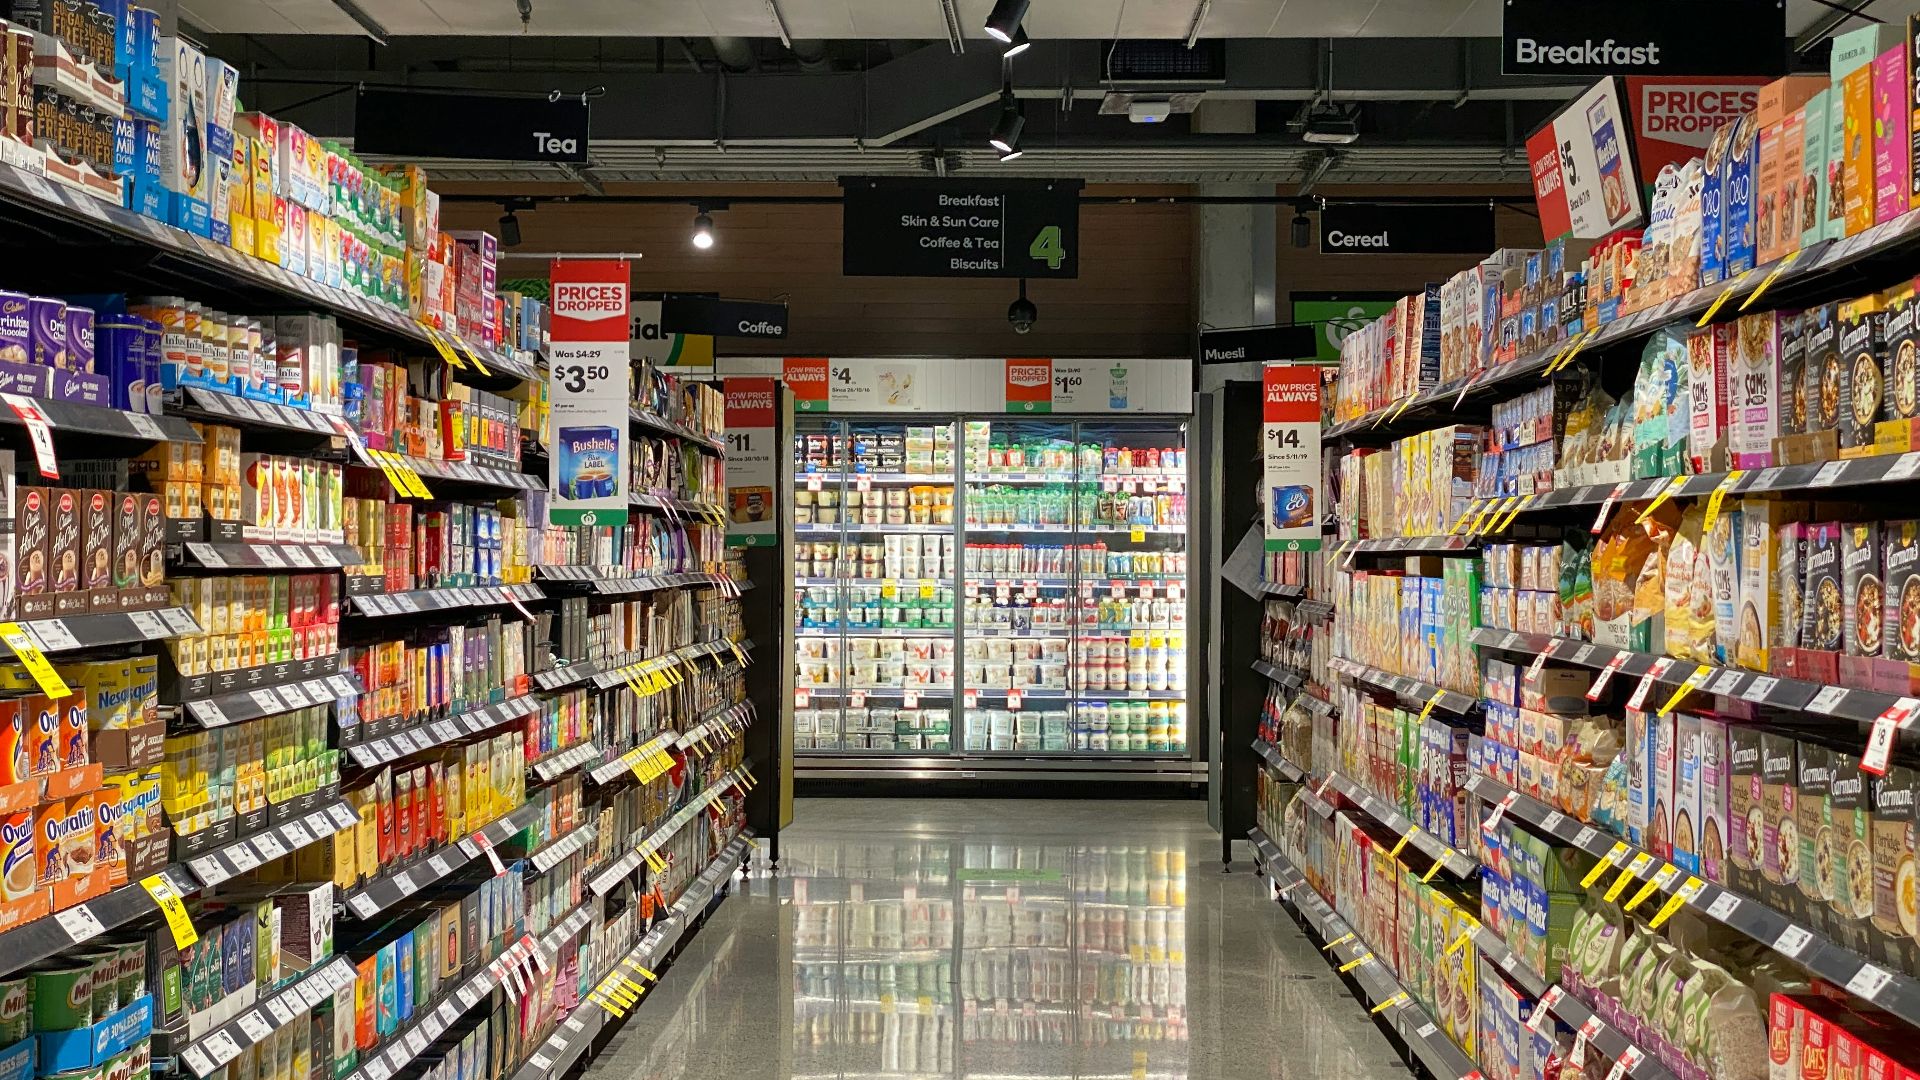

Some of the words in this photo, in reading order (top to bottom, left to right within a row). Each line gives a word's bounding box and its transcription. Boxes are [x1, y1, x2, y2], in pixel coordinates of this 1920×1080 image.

[1516, 39, 1660, 65] Breakfast
[1648, 91, 1757, 113] PRICES
[533, 132, 577, 154] Tea
[1534, 157, 1544, 177] LOW
[1543, 150, 1557, 168] PRICE
[1561, 140, 1577, 186] $5
[1537, 167, 1561, 198] ALWAYS
[939, 195, 999, 206] Breakfast
[901, 216, 927, 227] Skin
[930, 216, 940, 226] &
[943, 217, 966, 227] Sun
[969, 217, 999, 228] Care
[920, 236, 960, 248] Coffee
[963, 238, 973, 248] &
[975, 238, 999, 249] Tea
[1328, 231, 1389, 247] Cereal
[1029, 226, 1066, 270] 4
[950, 258, 999, 270] Biscuits
[558, 287, 622, 300] PRICES
[557, 301, 622, 311] DROPPED
[738, 321, 782, 335] Coffee
[1840, 316, 1870, 354] Carman's
[555, 350, 574, 358] Was
[1205, 347, 1245, 361] Muesli
[786, 373, 826, 382] ALWAYS
[787, 366, 804, 374] LOW
[805, 366, 826, 374] PRICE
[832, 367, 851, 384] $4
[1011, 368, 1047, 376] PRICES
[750, 391, 772, 399] PRICE
[1268, 384, 1289, 392] LOW
[726, 399, 773, 409] ALWAYS
[1267, 391, 1318, 402] ALWAYS
[573, 438, 615, 453] Bushells
[727, 434, 750, 451] $11
[1268, 429, 1300, 449] $14
[584, 461, 605, 469] LABEL
[1887, 539, 1919, 570] Carman's
[1731, 740, 1758, 765] Carman's
[1763, 749, 1791, 774] Carman's
[1830, 770, 1862, 796] Carman's
[1771, 1027, 1788, 1056] OATS
[1803, 1045, 1826, 1073] OATS
